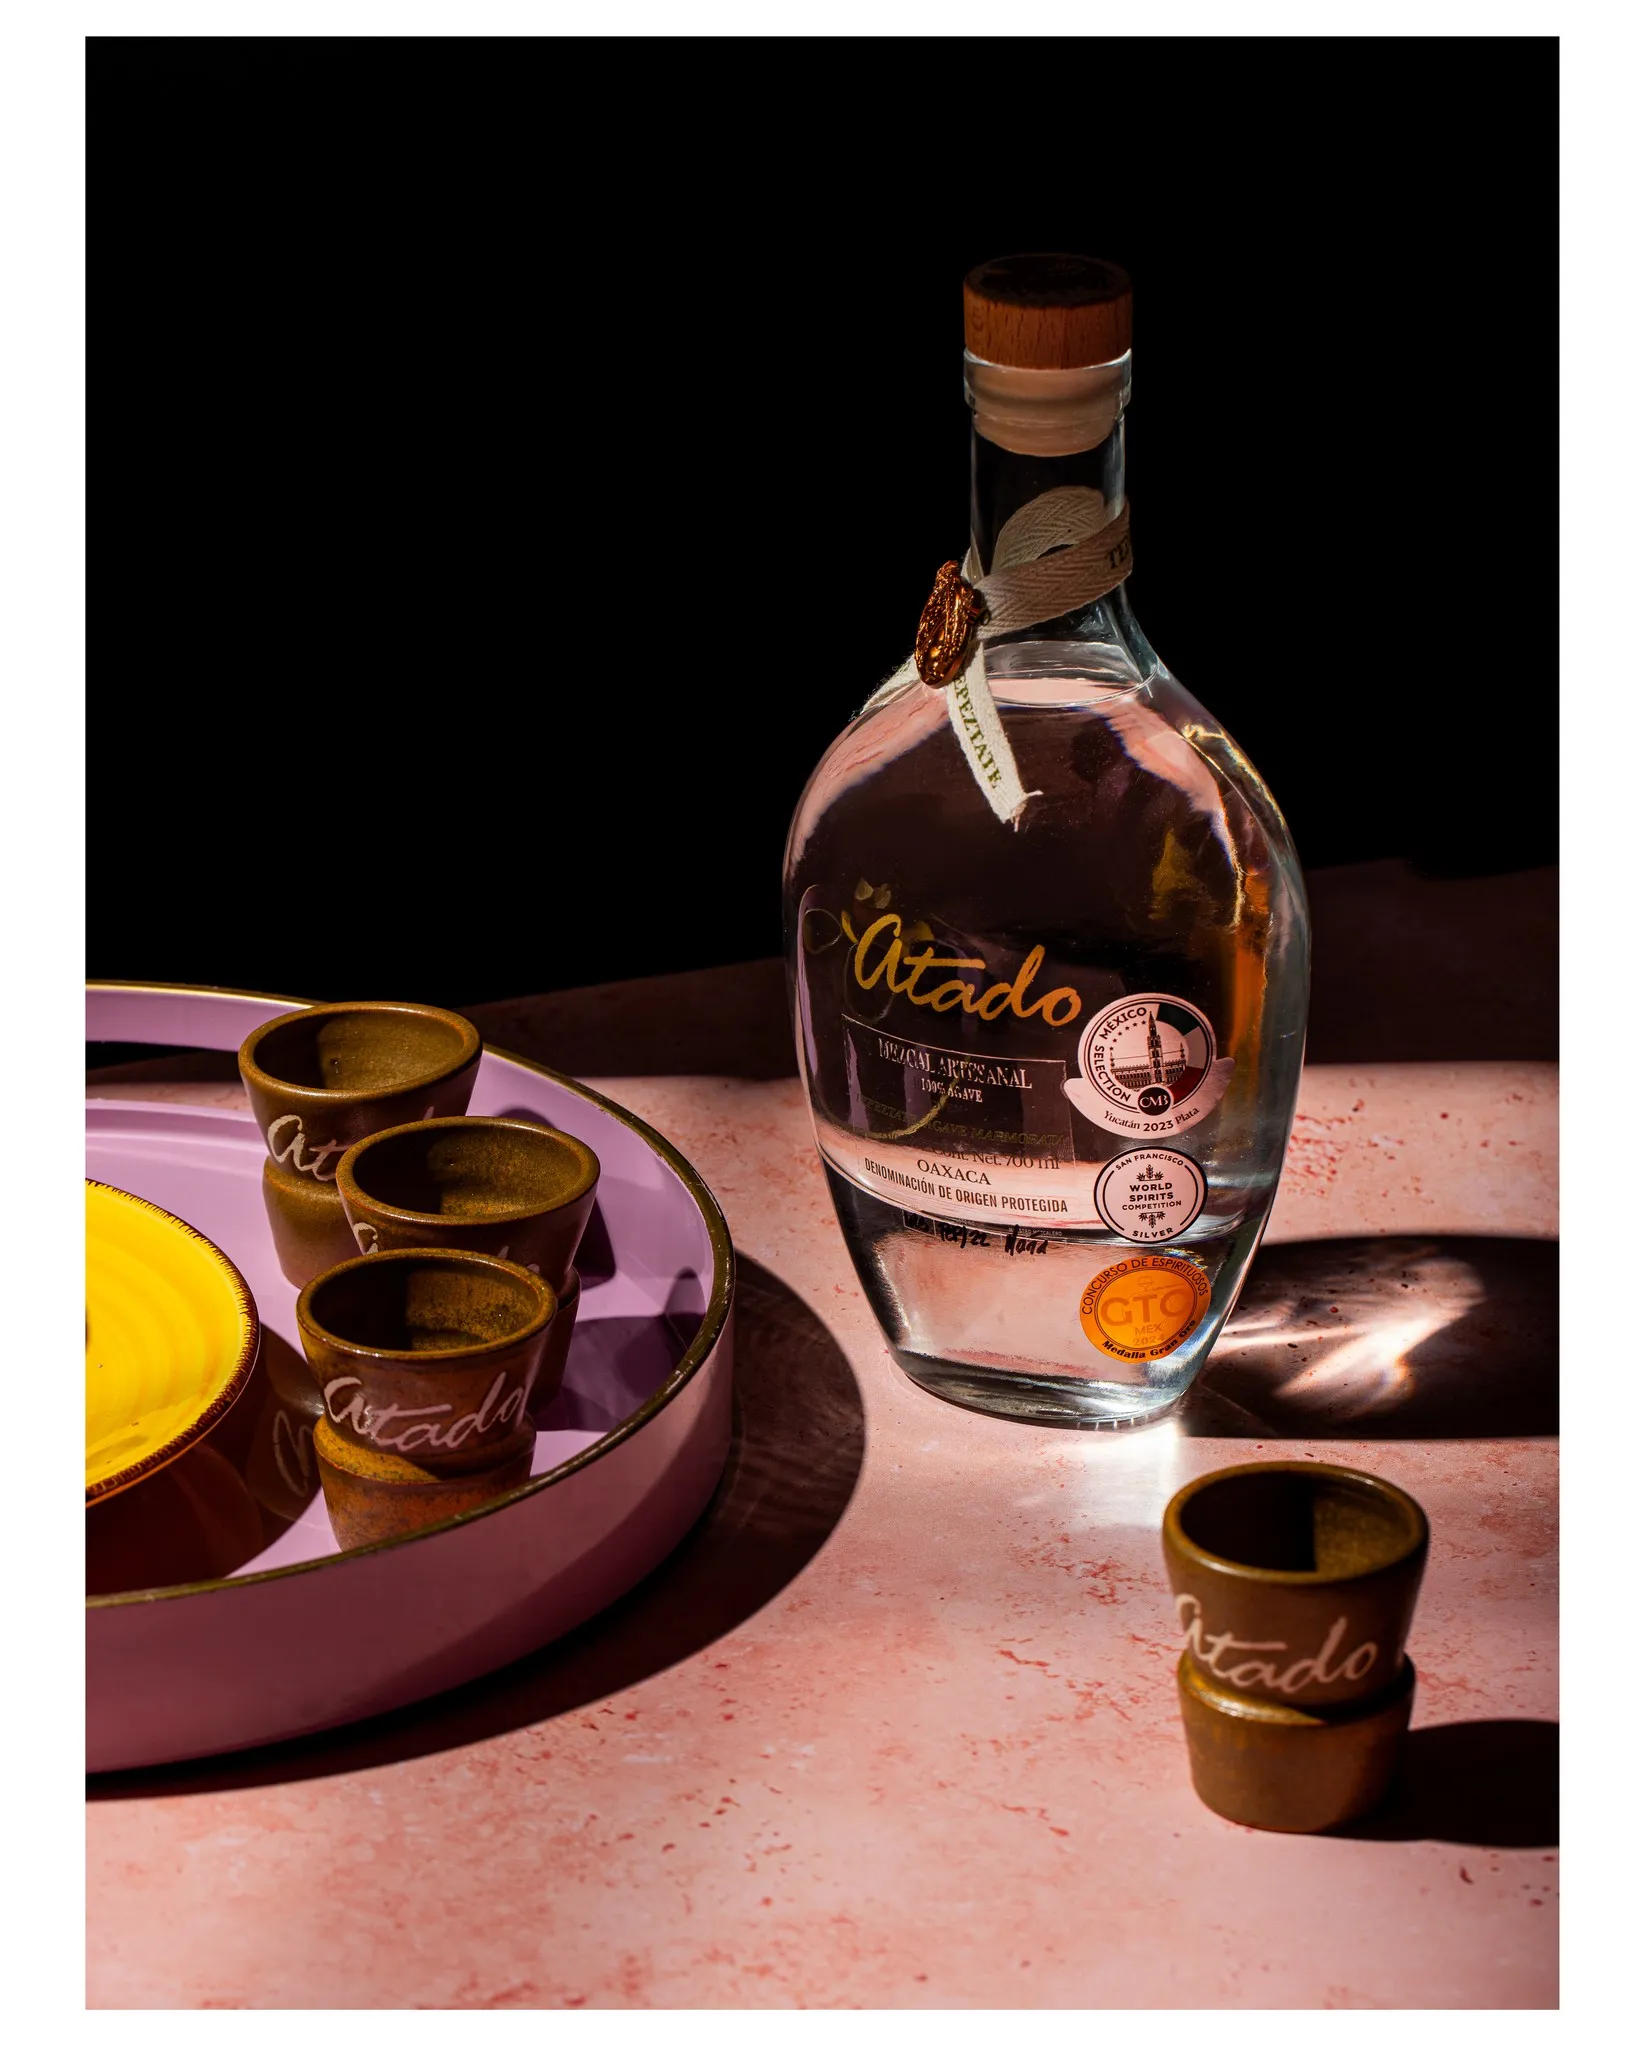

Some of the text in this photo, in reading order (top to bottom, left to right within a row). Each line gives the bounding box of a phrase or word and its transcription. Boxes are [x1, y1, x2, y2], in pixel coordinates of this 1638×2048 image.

[954, 675, 1001, 789] EPEZTATE
[855, 913, 1082, 1027] Atado
[1100, 1007, 1147, 1040] MÉXICO
[1094, 1045, 1131, 1102] SELECTION
[1139, 1095, 1169, 1109] CMB
[1104, 1107, 1200, 1132] Yucatán 2023 Plata
[916, 1158, 992, 1186] OAXACA
[972, 1149, 1002, 1166] Net.
[1005, 1155, 1034, 1169] 700
[1038, 1155, 1061, 1170] ml
[1115, 1153, 1184, 1171] SAN FRANCISCO
[864, 1157, 1068, 1213] DENOMINACIÓN DE ORIGEN PROTEGIDA
[1129, 1182, 1173, 1192] WORLD
[1129, 1192, 1174, 1202] SPIRITS
[1121, 1200, 1182, 1211] COMPETITION
[1132, 1227, 1174, 1239] SILVER
[1082, 1257, 1209, 1315] CONCURSO DE ESPIRITUOSOS
[1100, 1288, 1189, 1327] GTO
[1102, 1319, 1196, 1359] Medalla Gran Oro
[1133, 1334, 1164, 1347] 2024
[1134, 1323, 1163, 1336] MEX
[1175, 1593, 1378, 1693] Atado
